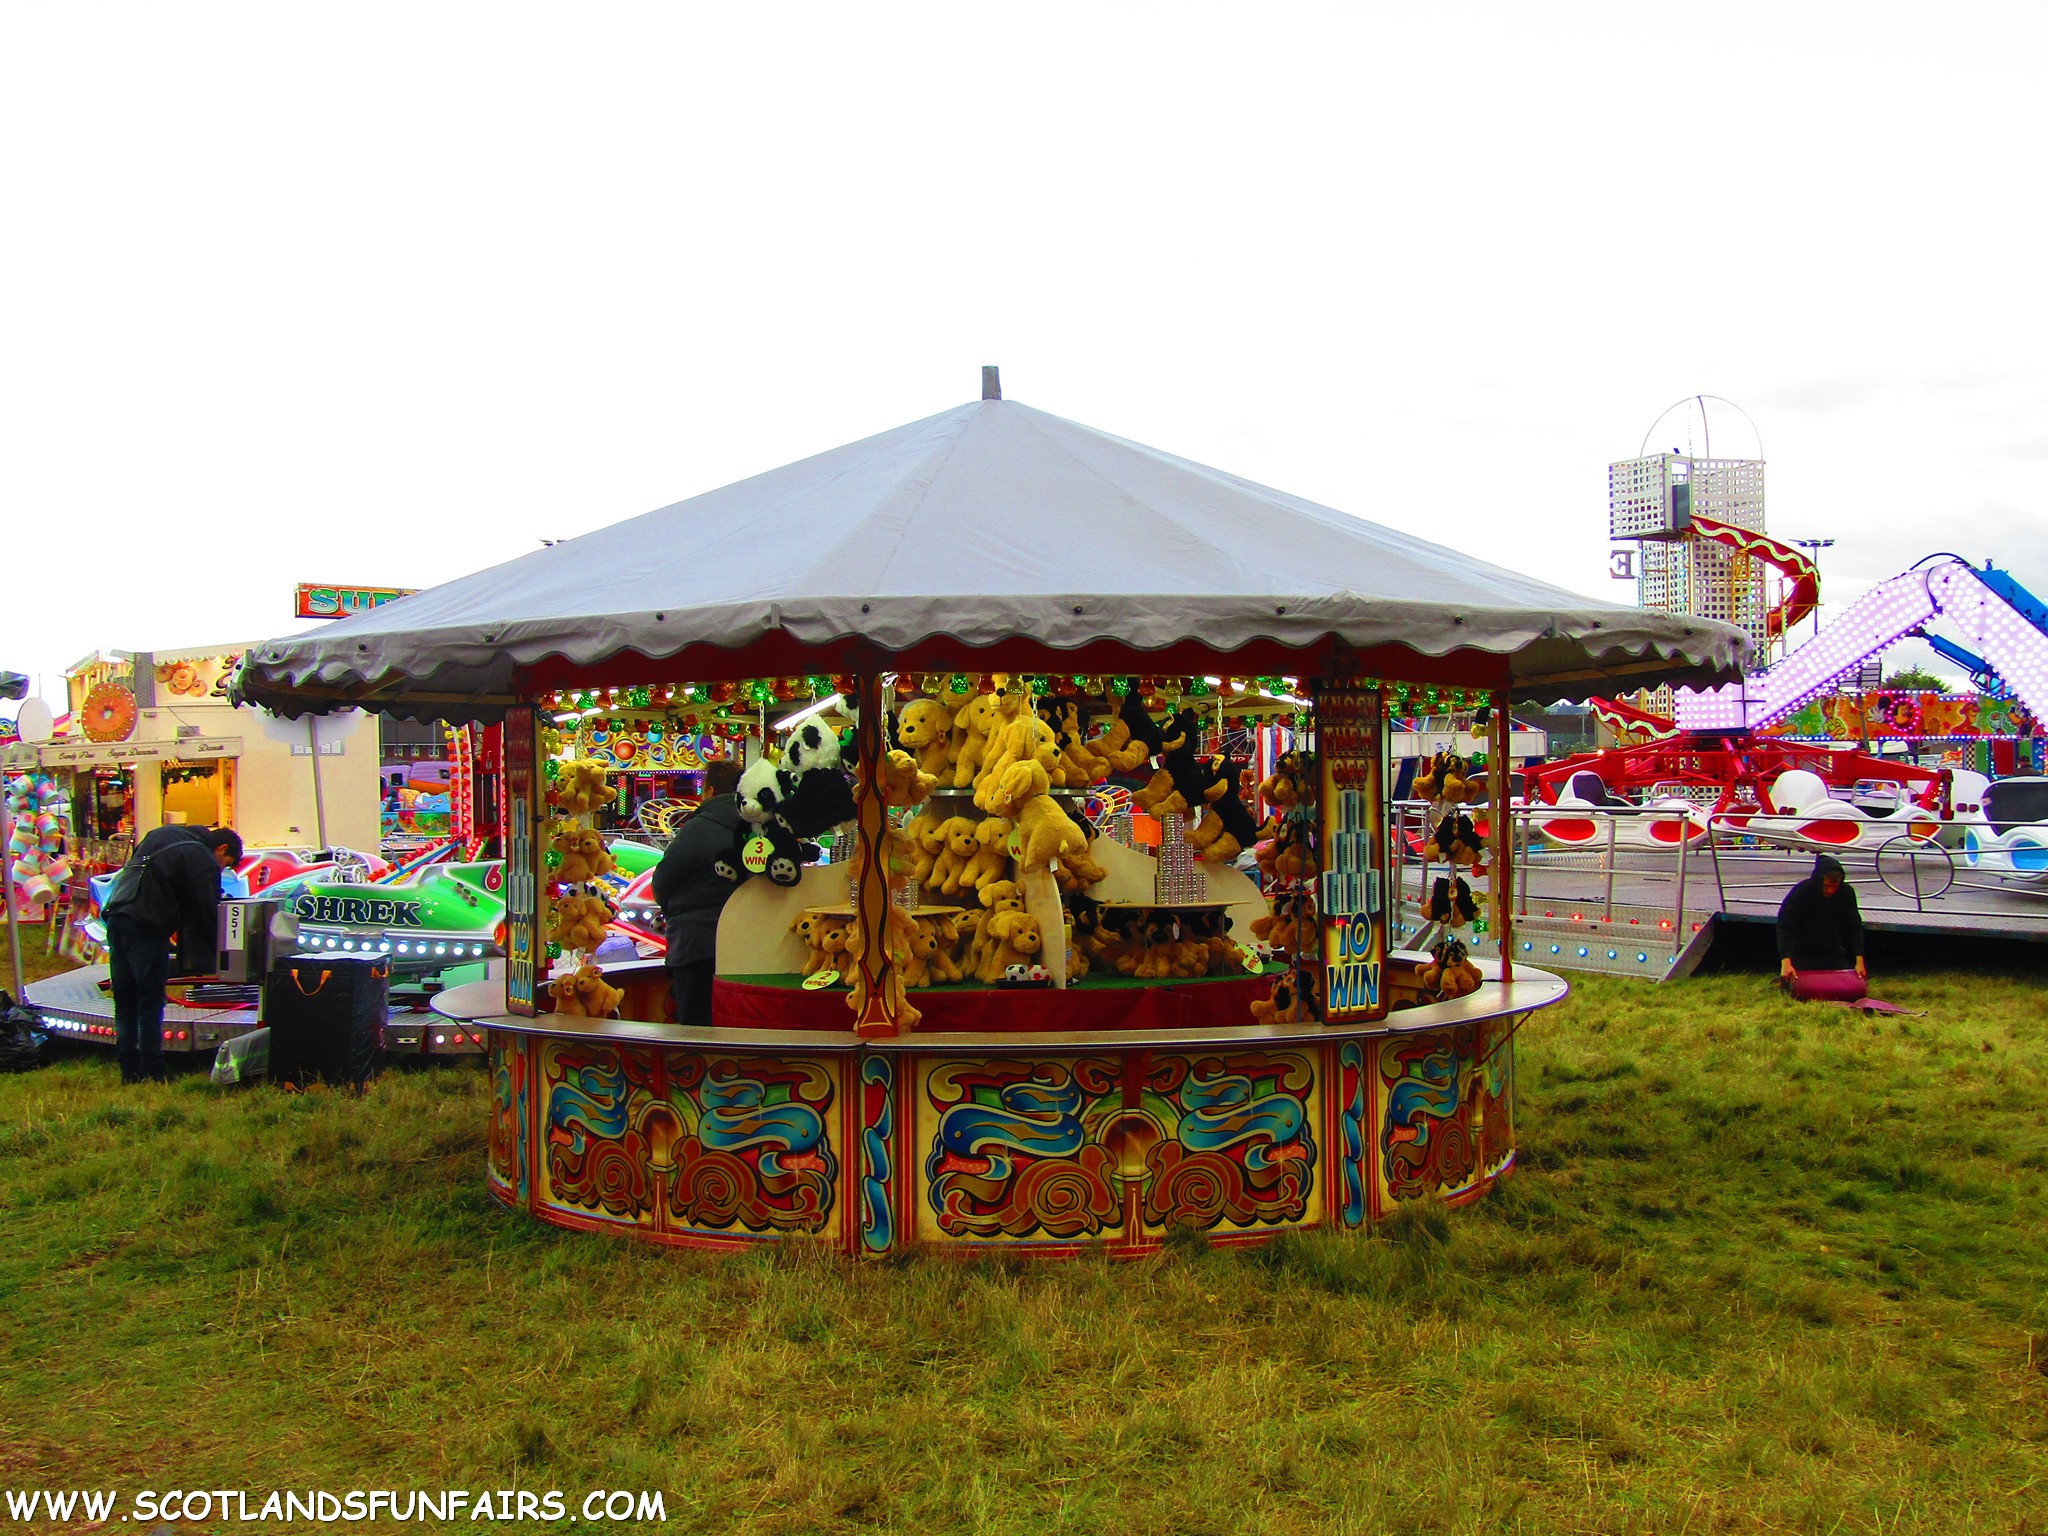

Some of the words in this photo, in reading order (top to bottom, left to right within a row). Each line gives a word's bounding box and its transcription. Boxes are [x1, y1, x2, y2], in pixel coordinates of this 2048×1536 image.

[755, 841, 764, 854] 3
[484, 864, 504, 891] 6
[296, 894, 423, 927] SHREK
[513, 911, 530, 957] TO
[1335, 911, 1371, 961] TO
[509, 957, 534, 1006] WIN
[1326, 962, 1380, 1013] WIN
